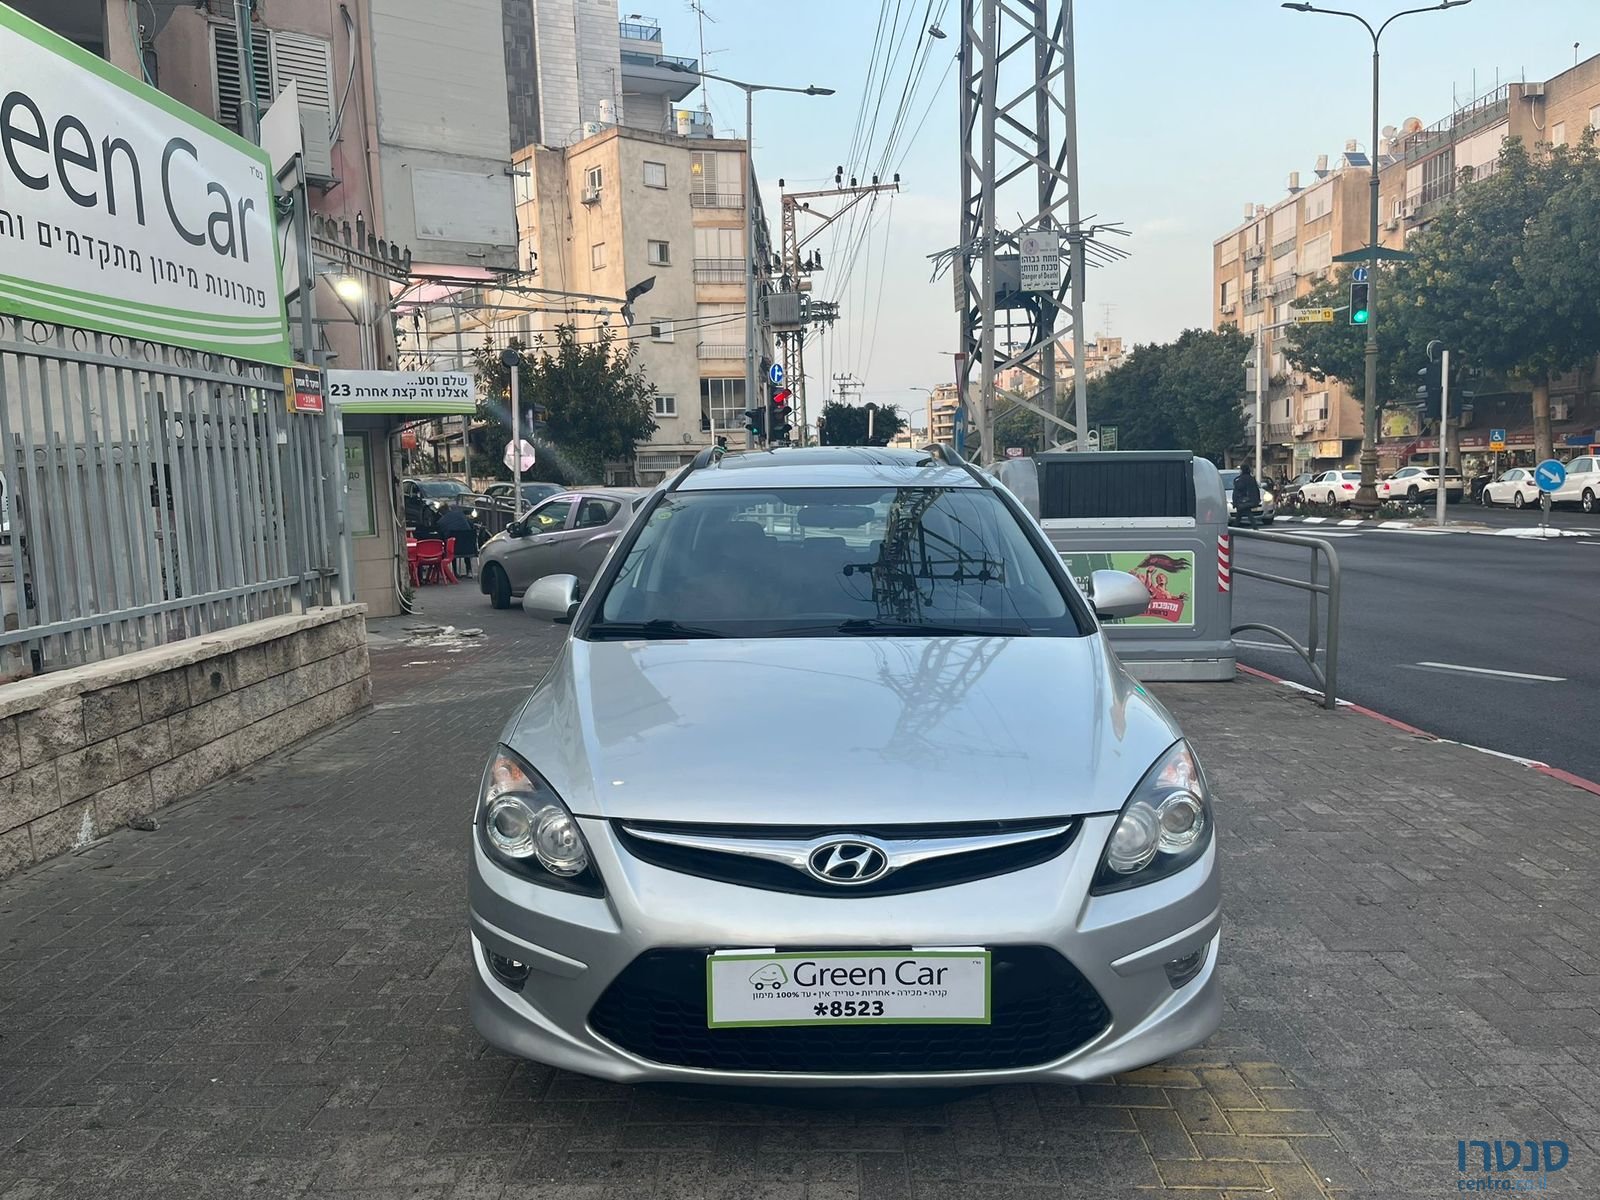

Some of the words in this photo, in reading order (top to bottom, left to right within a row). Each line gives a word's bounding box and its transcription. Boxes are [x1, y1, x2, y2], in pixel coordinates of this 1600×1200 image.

[161, 137, 254, 263] Car
[37, 221, 142, 273] מתקדמים
[150, 256, 199, 289] מימון
[205, 273, 266, 308] פתרונות
[407, 376, 439, 386] וסע...
[443, 375, 468, 386] שלם
[330, 384, 351, 397] 23
[356, 388, 389, 397] אחרת
[392, 387, 417, 399] קצת
[420, 387, 433, 397] זה
[437, 386, 469, 397] אצלנו
[793, 961, 886, 987] Green
[895, 960, 948, 985] Car
[753, 992, 774, 1000] מימון
[818, 990, 830, 998] אין
[861, 989, 890, 997] אחריות
[897, 989, 922, 997] מכירה
[929, 989, 947, 998] קניה
